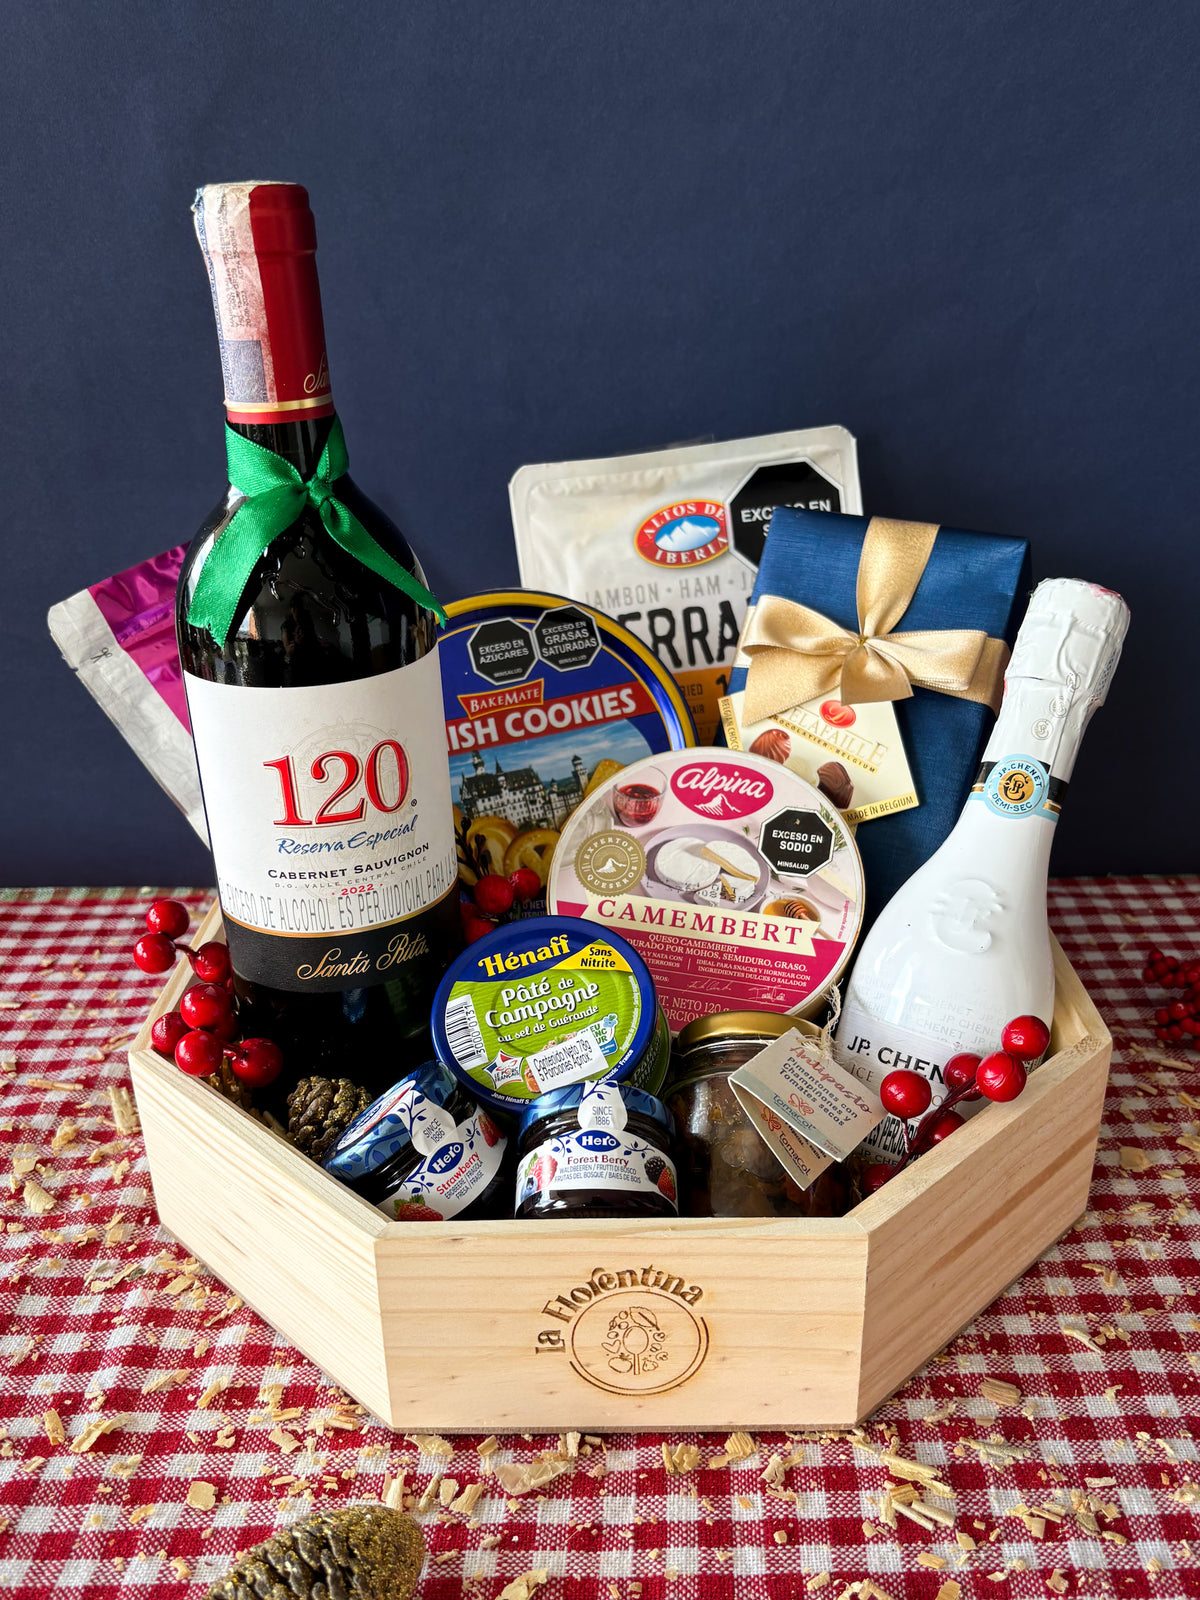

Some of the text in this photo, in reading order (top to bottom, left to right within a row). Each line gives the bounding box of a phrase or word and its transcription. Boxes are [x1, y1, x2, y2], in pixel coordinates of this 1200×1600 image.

[643, 502, 726, 540] ALTOS DE
[740, 503, 806, 523] EXC
[655, 537, 729, 564] IBERIA
[585, 583, 660, 610] JAMBON
[679, 575, 721, 600] HAM
[542, 621, 587, 636] EXCESO EN
[544, 628, 590, 646] GRASAS
[478, 639, 525, 656] EXCESO EN
[541, 637, 598, 657] SATURADAS
[493, 668, 523, 679] MINSALUD
[446, 688, 638, 751] ISH COOKIES
[786, 707, 889, 766] ELAFAILLE
[835, 748, 878, 774] BELGIUM
[263, 739, 412, 829] 120
[846, 795, 915, 822] MADE IN BELGIUM
[991, 792, 1034, 812] DEMI-SEC
[275, 815, 418, 855] Reserva Especial
[772, 829, 823, 844] EXCESO EN
[780, 840, 813, 853] SODIO
[583, 836, 634, 859] EXPERTOS
[268, 868, 347, 880] CABERNET
[354, 842, 430, 874] SAUVIGNON
[304, 881, 340, 889] VALLE
[347, 870, 395, 885] CENTRAL
[401, 856, 427, 871] CHILE
[777, 860, 810, 871] MINSALUD
[587, 866, 638, 889] QUESEROS
[260, 895, 276, 929] DE
[279, 897, 335, 932] ALCOHOL
[338, 895, 354, 930] ES
[358, 873, 427, 926] PERJUDICIAL
[426, 862, 447, 902] PARA
[341, 883, 375, 896] 2022
[596, 898, 804, 946] CAMEMBERT
[478, 934, 571, 977] Hénaff
[588, 946, 613, 957] Sans
[649, 934, 740, 954] QUESO CAMEMBERT
[296, 948, 371, 980] Santa
[580, 957, 616, 969] Nitrite
[647, 958, 680, 968] TERROSOS
[652, 952, 668, 960] NATA
[669, 954, 684, 962] CON
[666, 943, 684, 954] POR
[775, 960, 808, 972] GRASO.
[696, 959, 716, 968] IDEAL
[716, 961, 732, 970] PARA
[733, 964, 757, 974] SNACKS
[763, 969, 795, 979] HORNEAR
[796, 973, 811, 982] CON
[697, 966, 745, 978] INGREDIENTES
[745, 972, 771, 983] DULCES
[777, 978, 808, 988] SALADOS
[501, 977, 575, 1008] Pâté de
[485, 982, 600, 1028] Campagne
[673, 996, 722, 1014] NETO 120
[497, 1004, 600, 1043] au sel de Guérande
[533, 1050, 563, 1072] Contenido
[563, 1044, 580, 1060] Neto
[579, 1039, 593, 1054] 78g
[848, 1035, 945, 1085] JP. CHEN
[539, 1072, 545, 1082] 5
[543, 1061, 574, 1080] Porciones
[789, 1046, 872, 1114] Antipasto
[850, 1063, 875, 1083] ICE
[779, 1068, 845, 1127] Tomates secos
[783, 1063, 843, 1116] Champiñones
[787, 1056, 858, 1119] Pimentones con
[592, 1106, 613, 1116] SINCE
[595, 1116, 611, 1126] 1886
[423, 1118, 442, 1139] SINCE
[430, 1129, 446, 1144] 1886
[582, 1135, 617, 1147] Hero
[432, 1144, 461, 1173] Hero
[466, 1160, 484, 1180] FRAGOLA
[559, 1165, 593, 1174] WALDBEEREN
[621, 1166, 637, 1175] BOSCO
[567, 1155, 629, 1166] Forest Berry
[436, 1151, 480, 1195] Strawberry
[554, 1174, 572, 1184] FRUTAS
[584, 1172, 604, 1180] BOSQUE
[623, 1174, 630, 1182] DE
[630, 1175, 641, 1184] BOIS
[456, 1170, 485, 1200] FRESA FRAISE
[541, 1264, 704, 1325] Florentina
